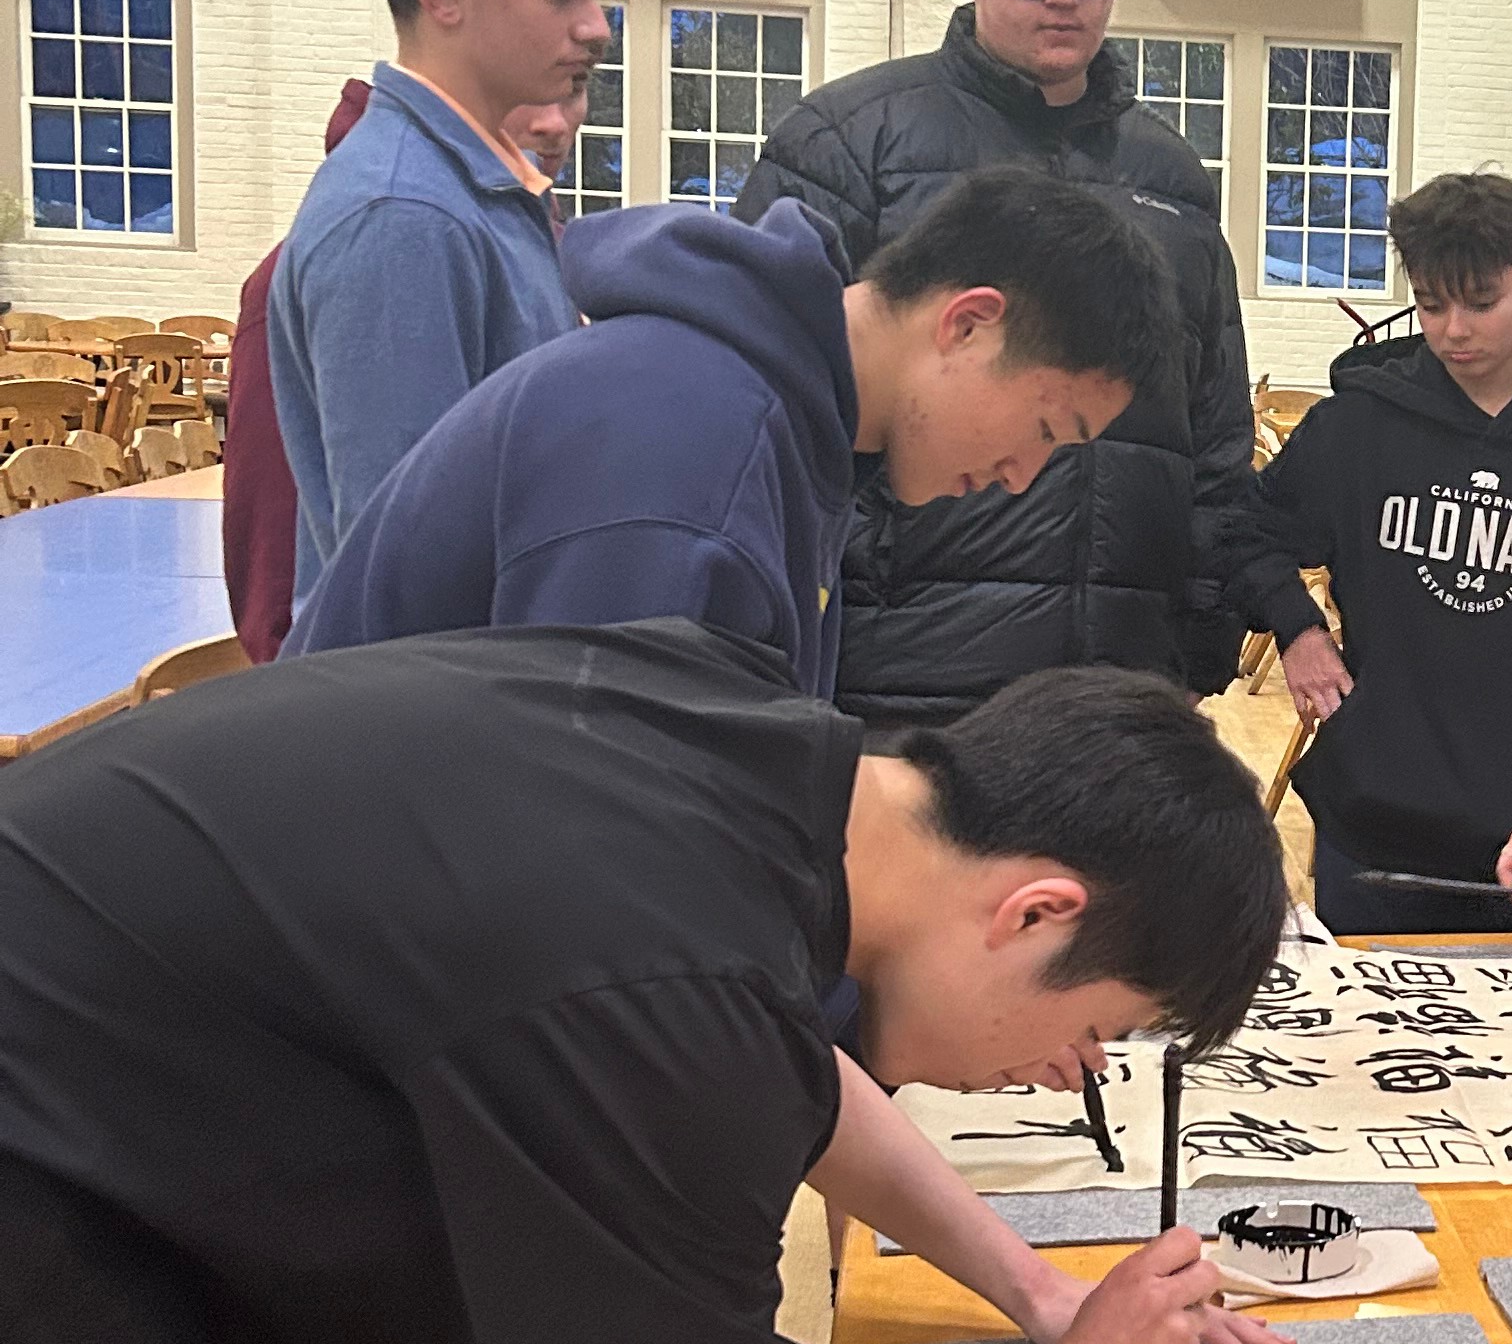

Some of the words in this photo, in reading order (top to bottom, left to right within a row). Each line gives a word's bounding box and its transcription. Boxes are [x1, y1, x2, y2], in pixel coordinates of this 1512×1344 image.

[1379, 495, 1461, 562] OLD
[1417, 565, 1504, 613] ESTABLISHED
[1455, 571, 1486, 593] 94
